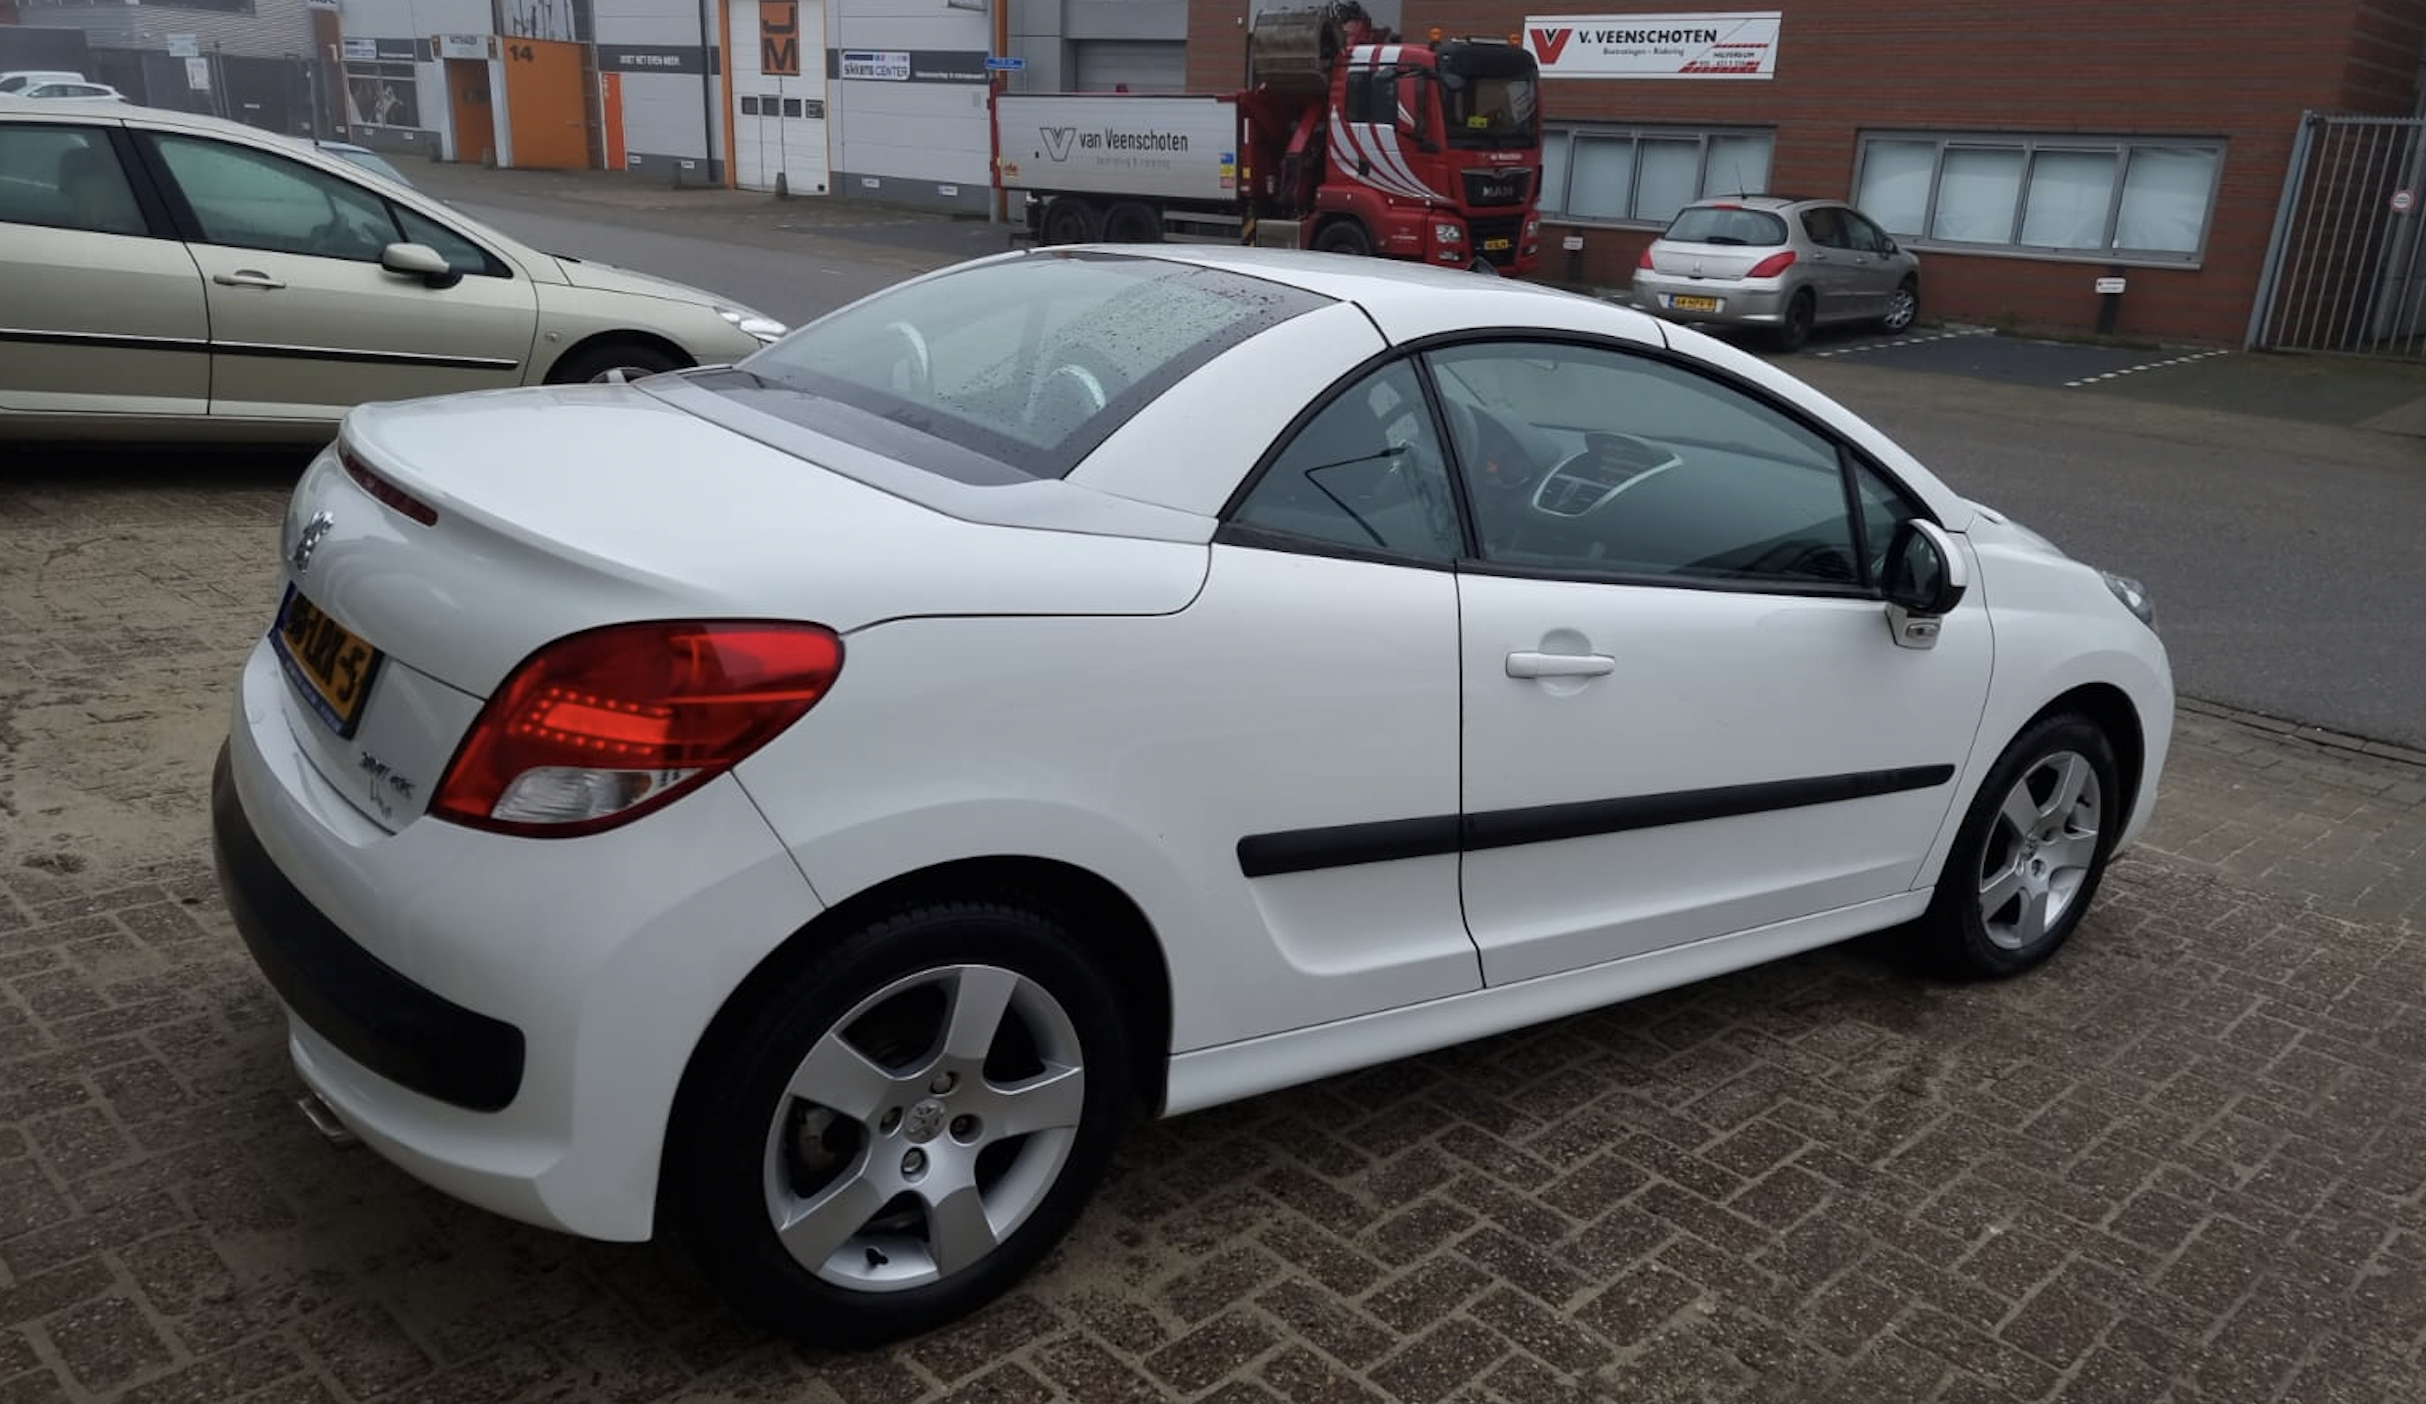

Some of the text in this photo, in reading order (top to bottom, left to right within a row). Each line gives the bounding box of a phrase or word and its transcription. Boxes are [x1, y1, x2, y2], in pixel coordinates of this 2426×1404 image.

[1579, 30, 1717, 44] V. VEENSCHOTEN
[510, 44, 533, 63] 14
[875, 66, 907, 77] CENTER
[1080, 128, 1188, 152] van Veenschoten
[1483, 186, 1513, 197] MAN
